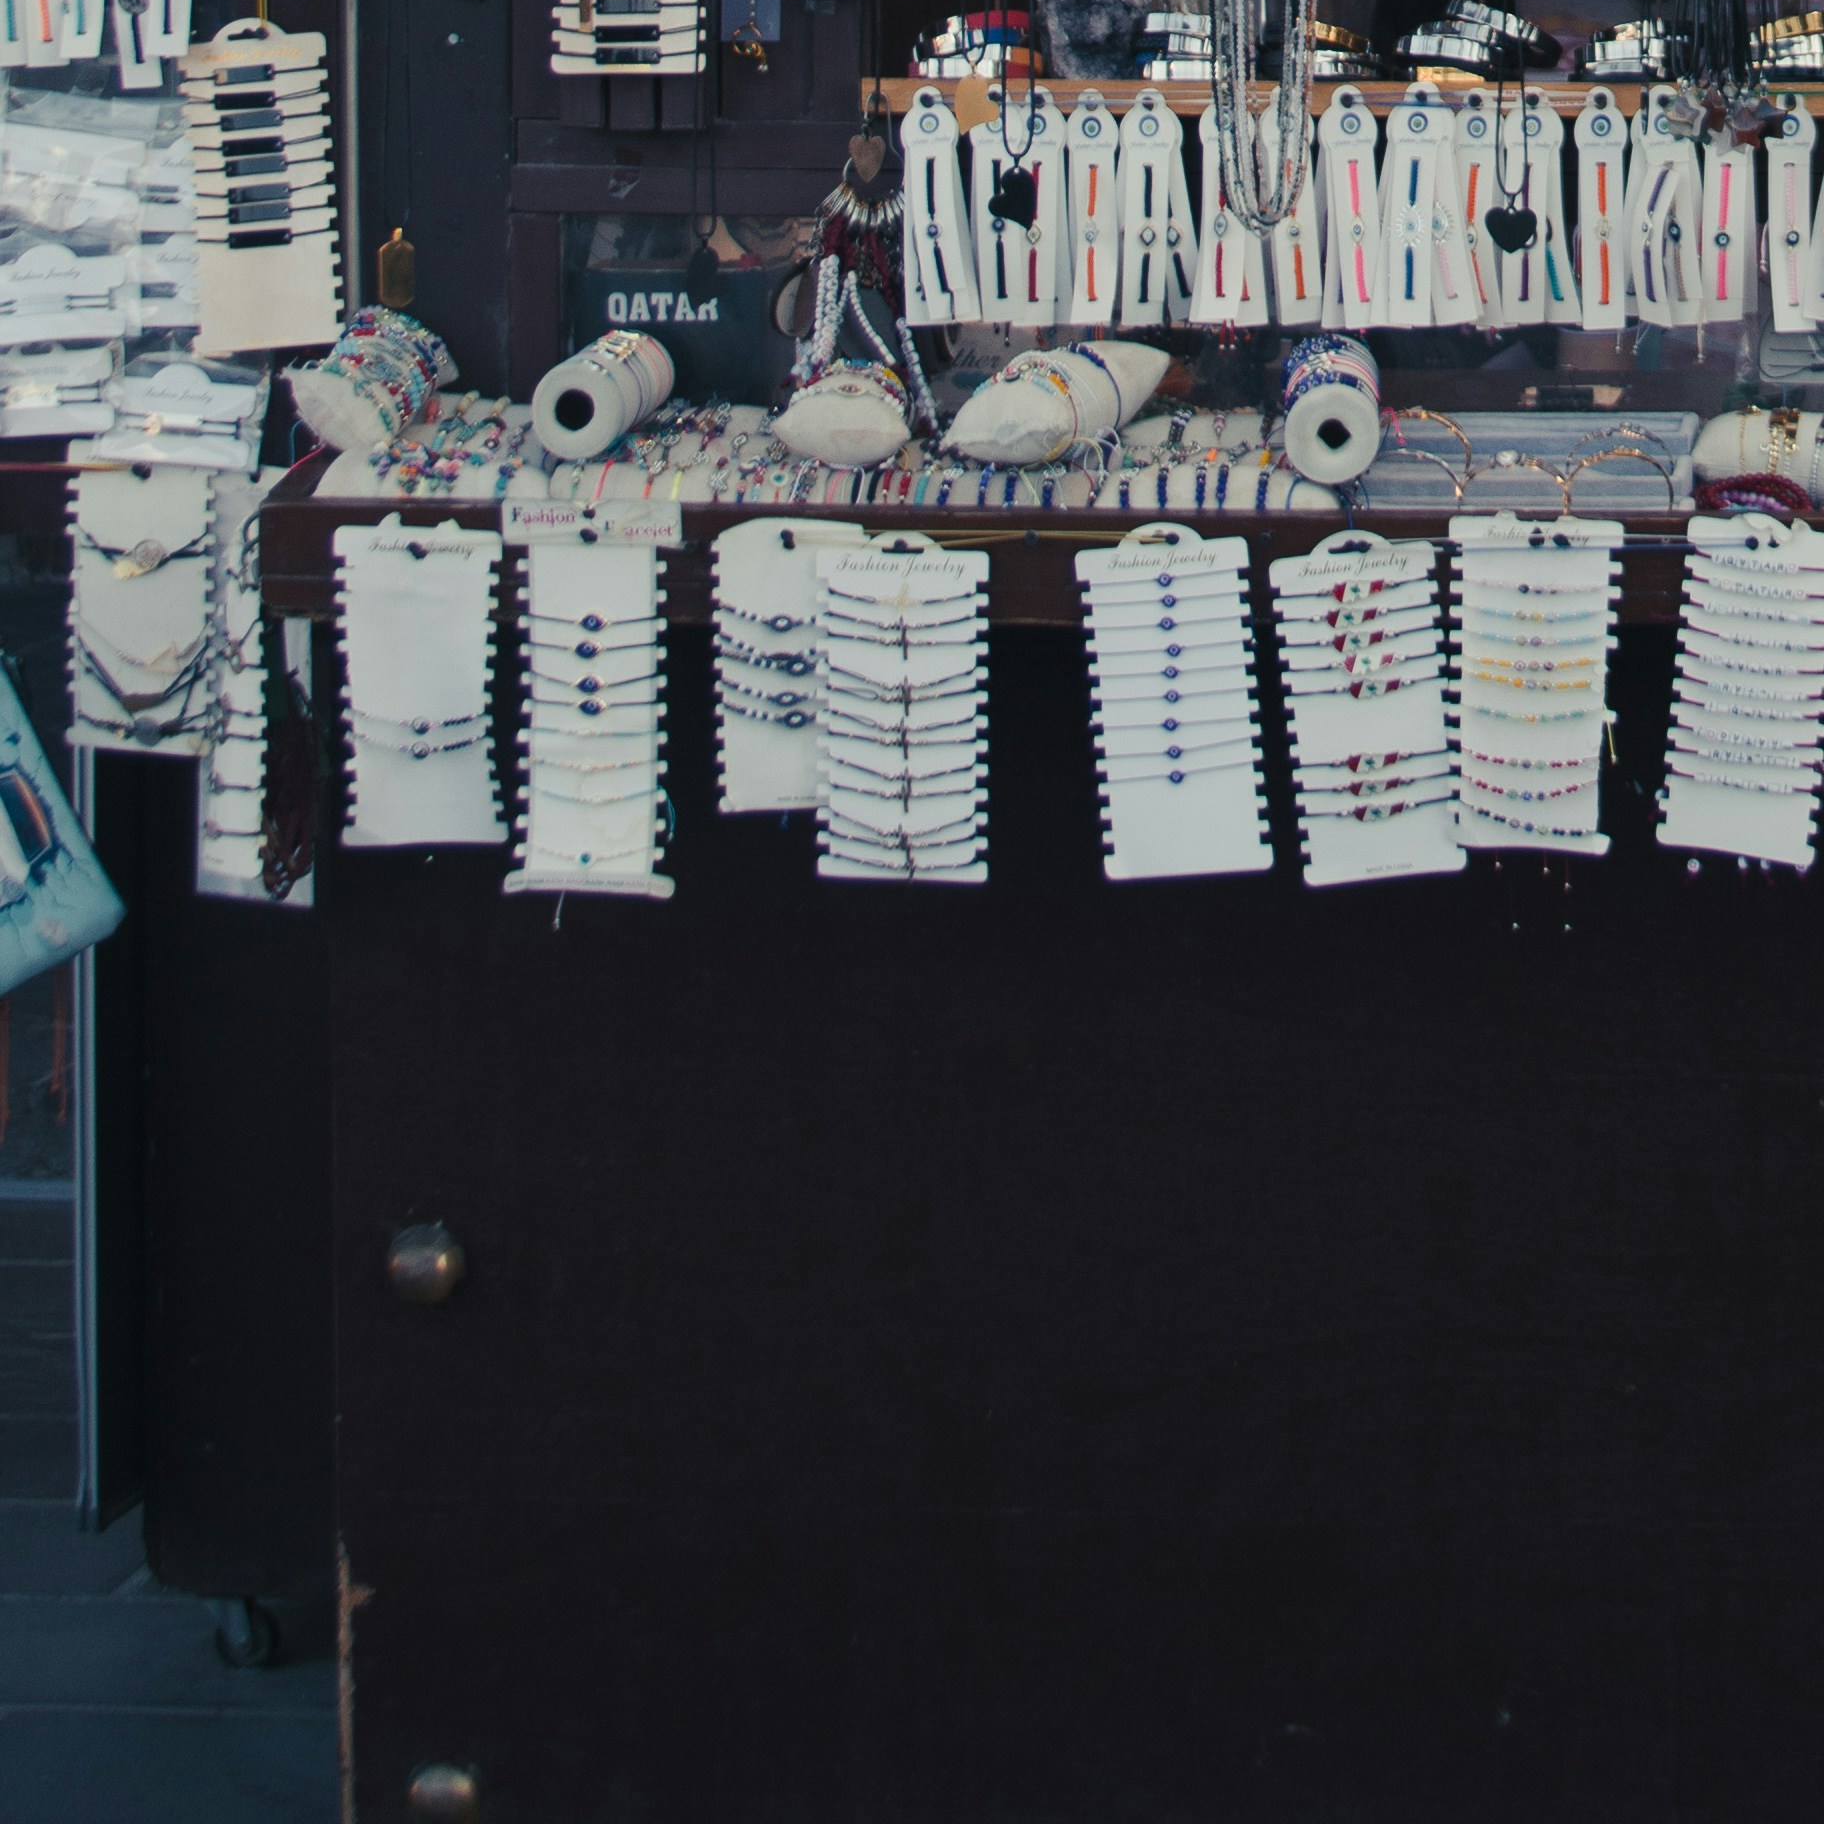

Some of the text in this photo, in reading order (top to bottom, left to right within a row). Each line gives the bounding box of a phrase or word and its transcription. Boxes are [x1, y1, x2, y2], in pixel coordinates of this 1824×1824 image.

[607, 290, 719, 323] QATAR
[510, 506, 576, 529] Fashion
[834, 554, 967, 580] Fashion Jewelry
[1106, 549, 1218, 570] Fashion Jewelry
[1298, 553, 1409, 578] Fashion Jewelry
